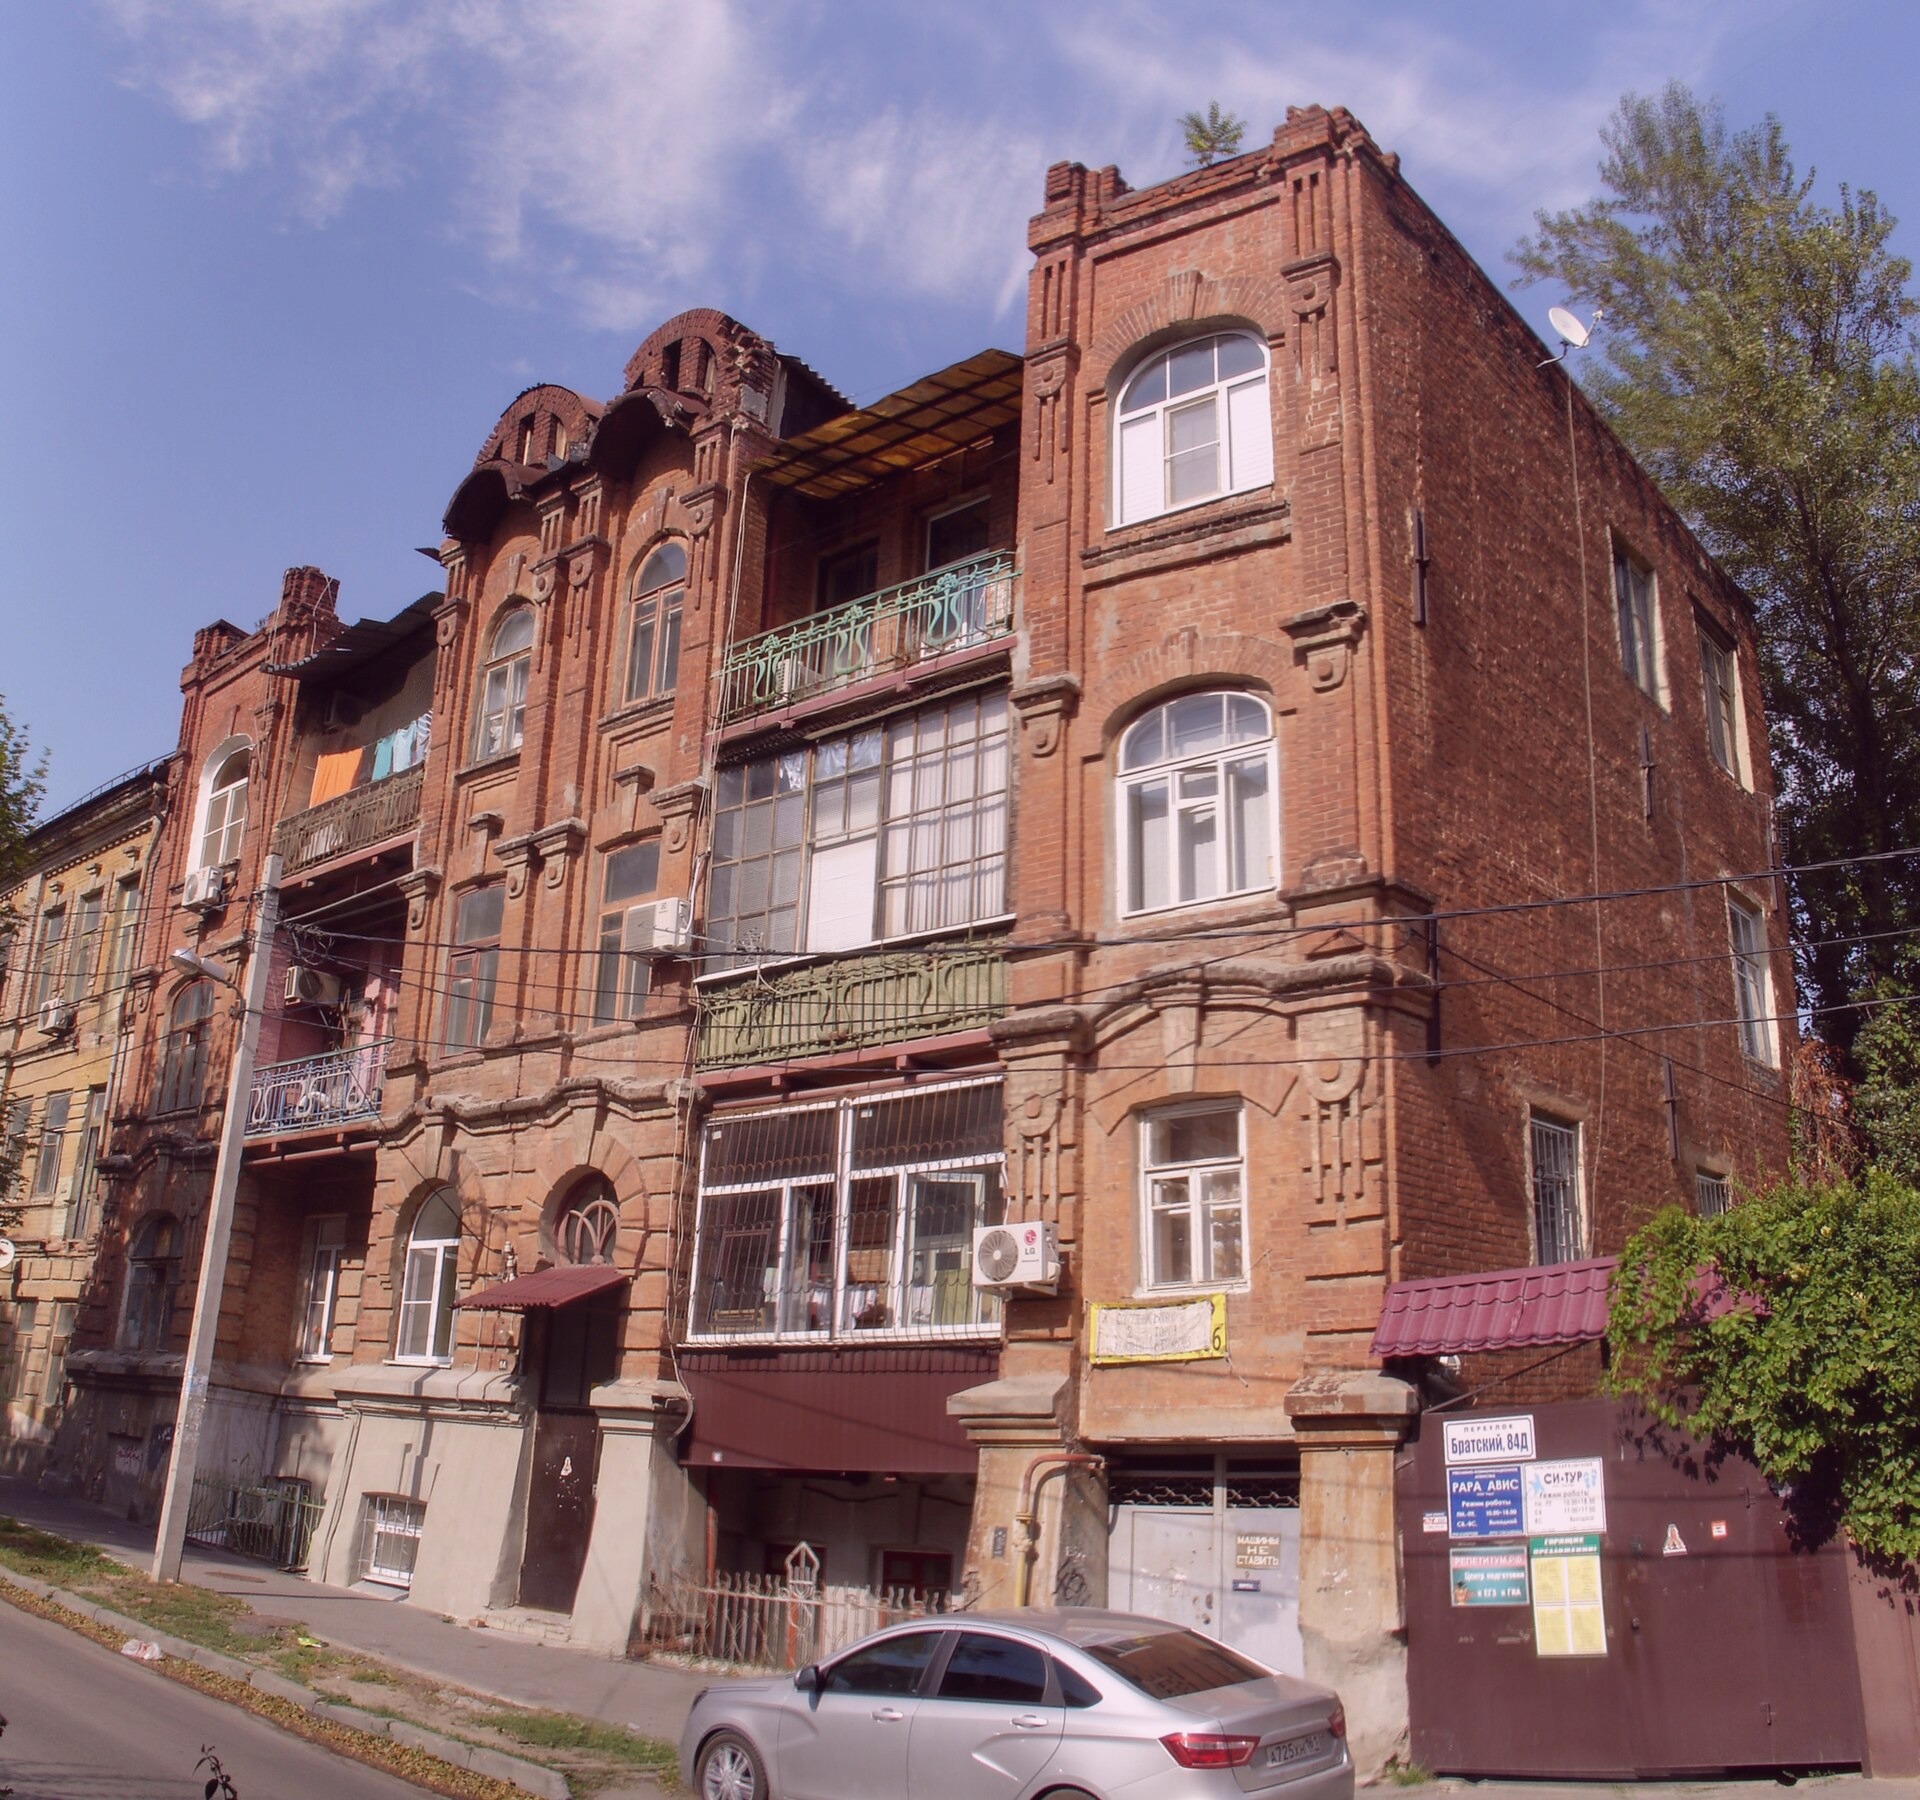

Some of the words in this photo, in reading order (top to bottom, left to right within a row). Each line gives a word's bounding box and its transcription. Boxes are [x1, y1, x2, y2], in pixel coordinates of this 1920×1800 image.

[1025, 1247, 1036, 1256] LG
[1464, 1423, 1513, 1433] ПЕРЕУЛОК
[1451, 1434, 1505, 1456] Братский,
[1507, 1432, 1529, 1452] 84Д
[1452, 1481, 1482, 1493] РАРА
[1487, 1479, 1519, 1491] АВИС
[1485, 1499, 1512, 1508] работы
[1237, 1536, 1280, 1545] МАШИНЫ
[1247, 1545, 1270, 1555] НЕ
[1236, 1555, 1280, 1566] СТАВИТЬ
[1464, 1571, 1485, 1582] Центр
